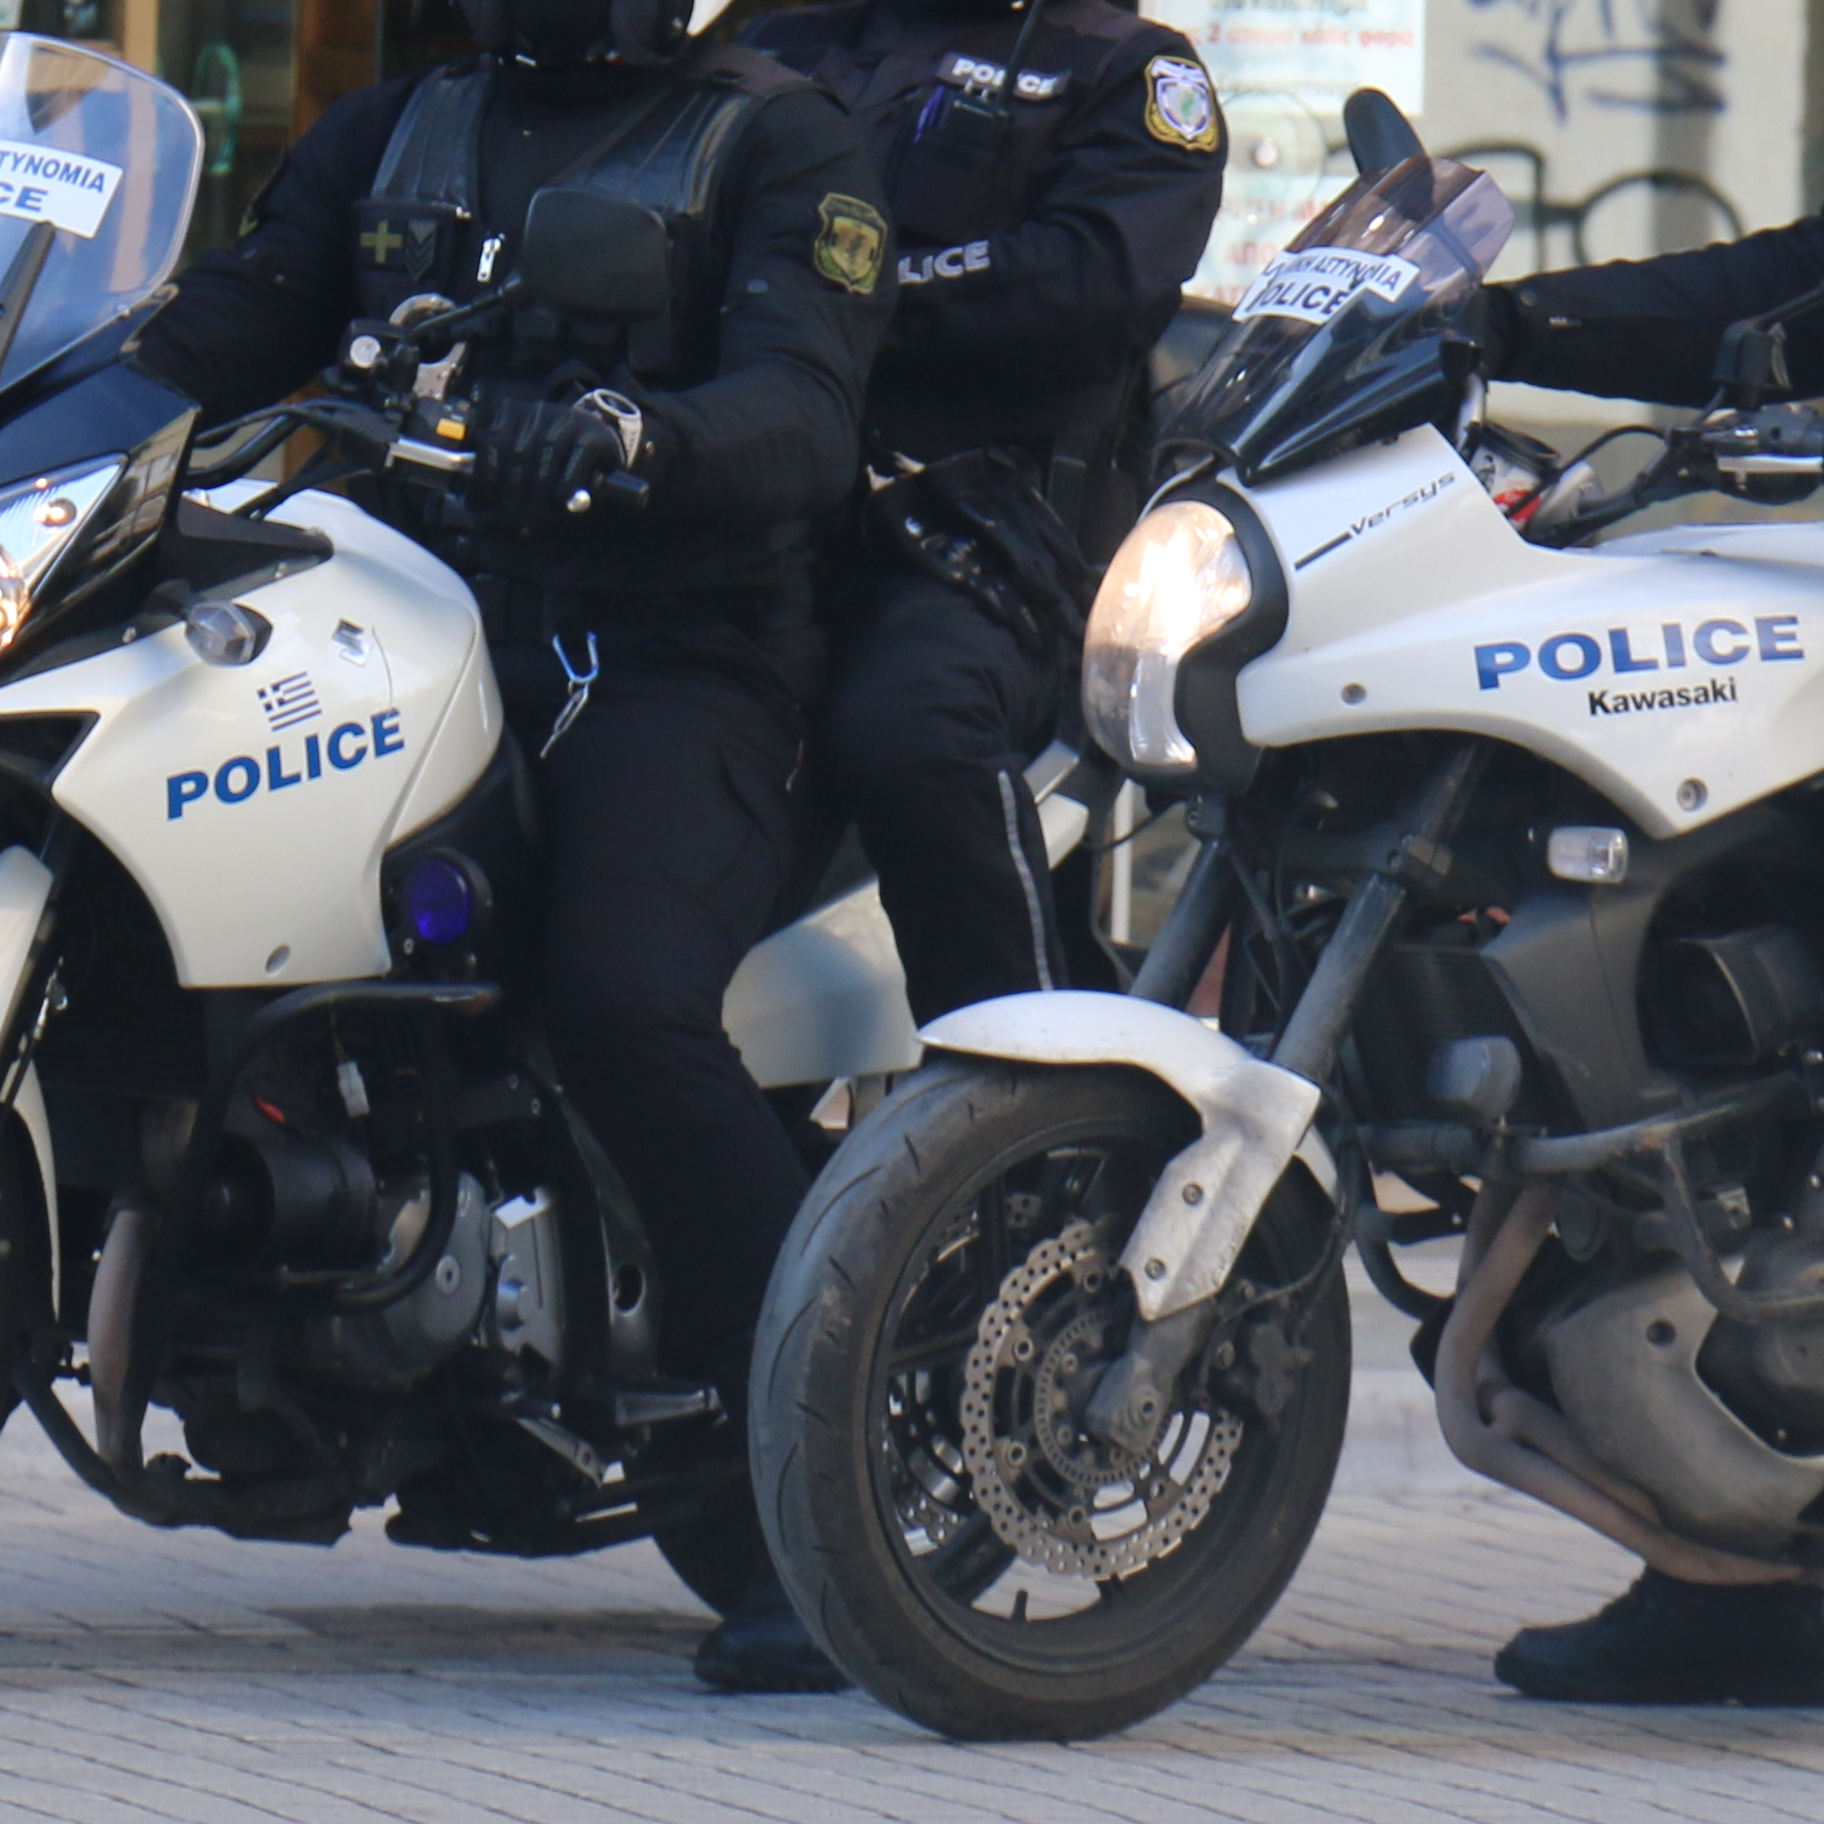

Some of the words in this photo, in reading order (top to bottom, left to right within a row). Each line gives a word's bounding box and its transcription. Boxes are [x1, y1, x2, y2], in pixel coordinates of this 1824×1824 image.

[951, 56, 1060, 95] POCE
[1473, 614, 1806, 691] POLICE
[1588, 677, 1739, 716] Kawasaki
[166, 707, 406, 821] POLICE
